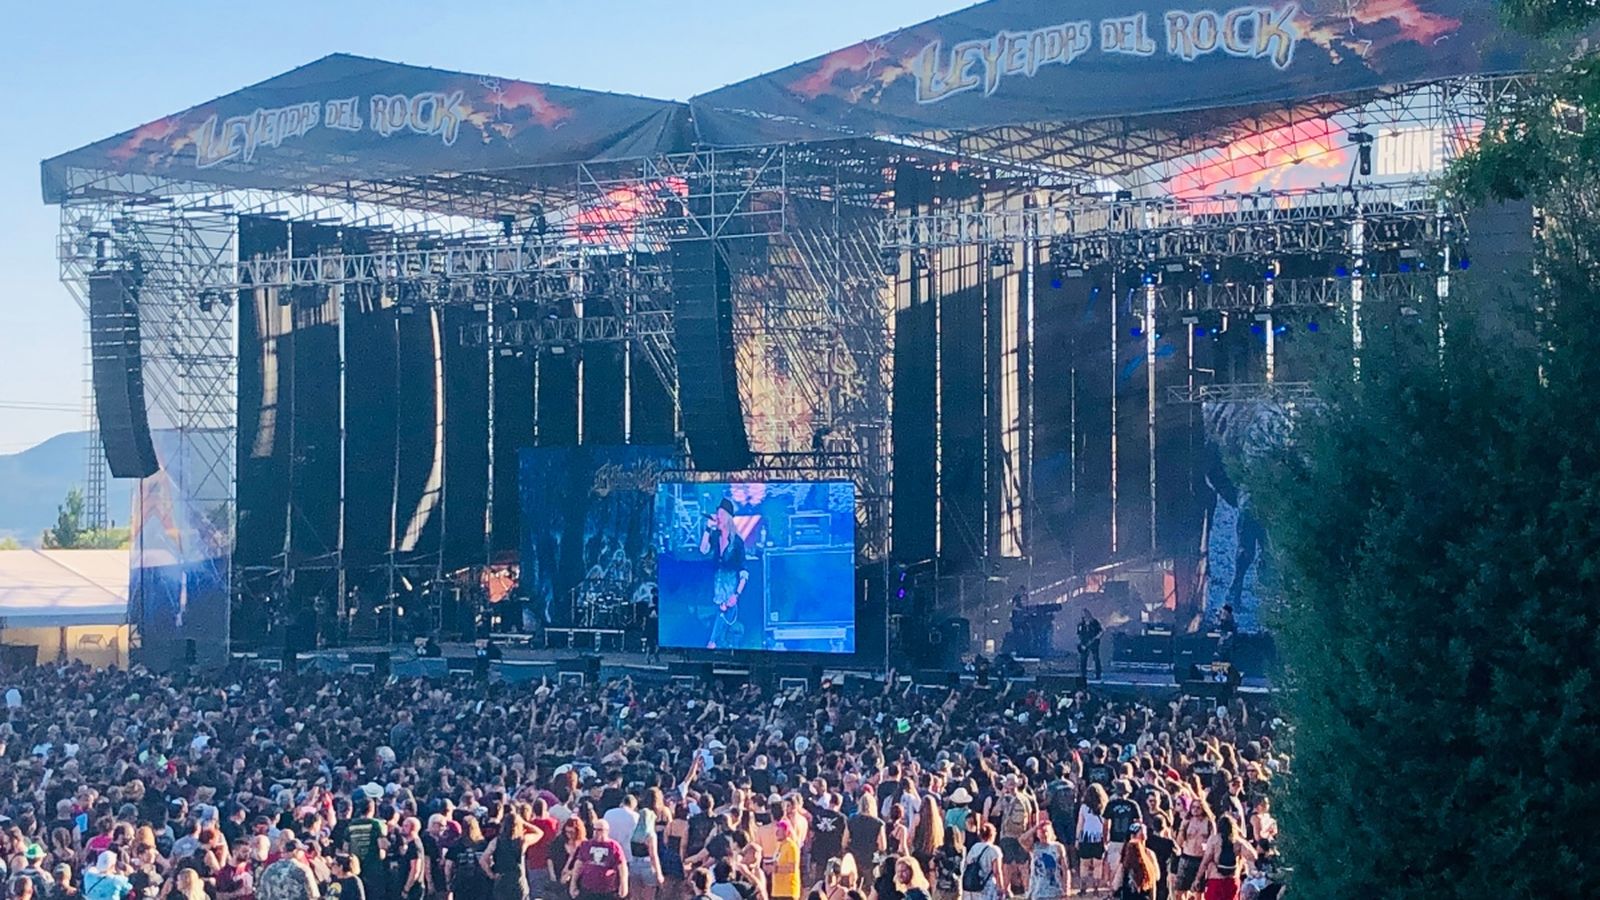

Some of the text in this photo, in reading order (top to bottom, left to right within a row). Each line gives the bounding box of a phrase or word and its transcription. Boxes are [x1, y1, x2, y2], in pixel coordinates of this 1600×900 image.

[916, 4, 1298, 103] LEYENDAS DEL ROCK
[195, 90, 464, 169] LEYENDAS DEL ROCK
